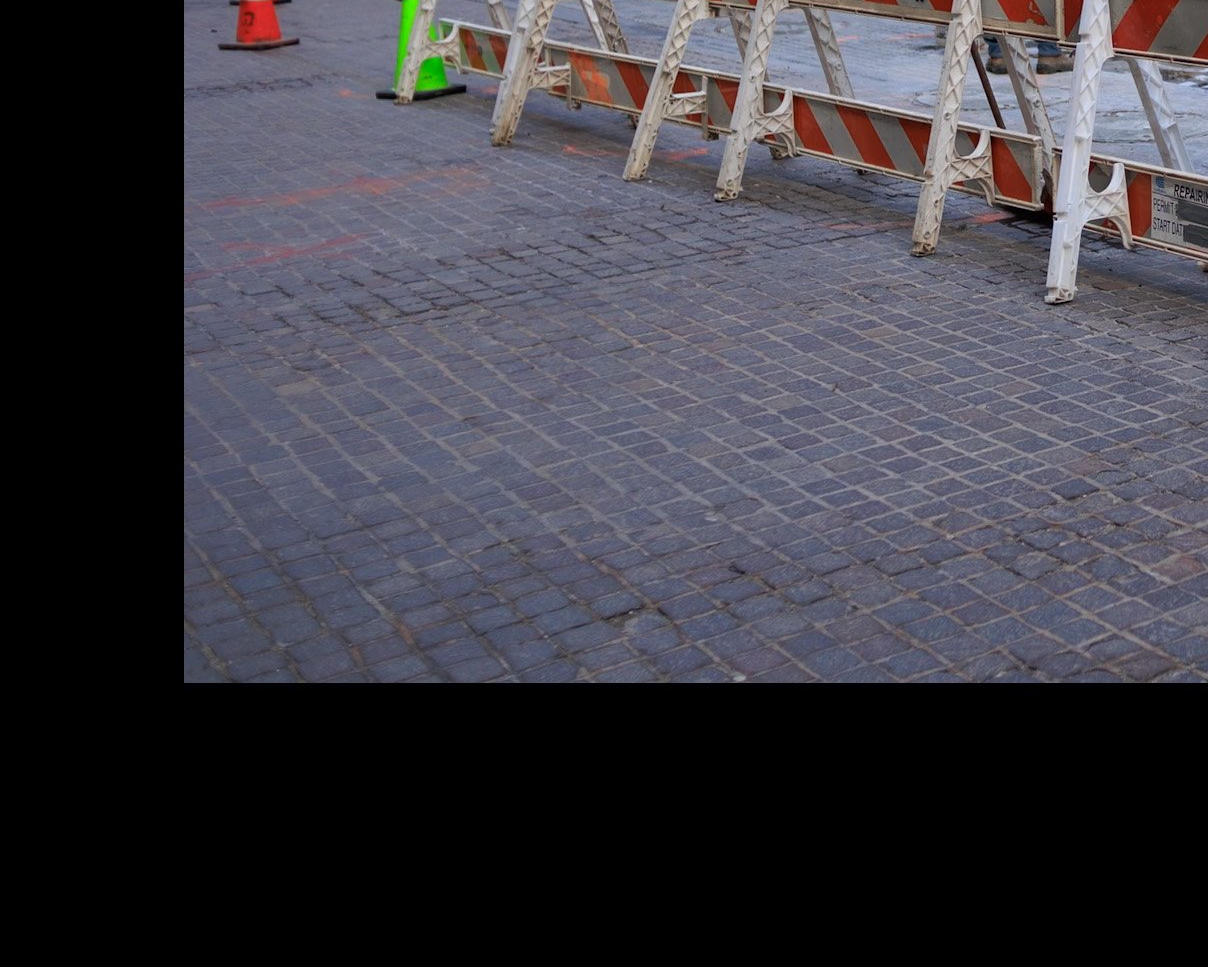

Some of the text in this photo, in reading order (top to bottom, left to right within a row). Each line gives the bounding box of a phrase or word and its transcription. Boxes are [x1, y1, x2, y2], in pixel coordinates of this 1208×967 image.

[1153, 198, 1174, 216] PERMIT
[1153, 217, 1171, 234] START
[1172, 221, 1184, 236] DAT
